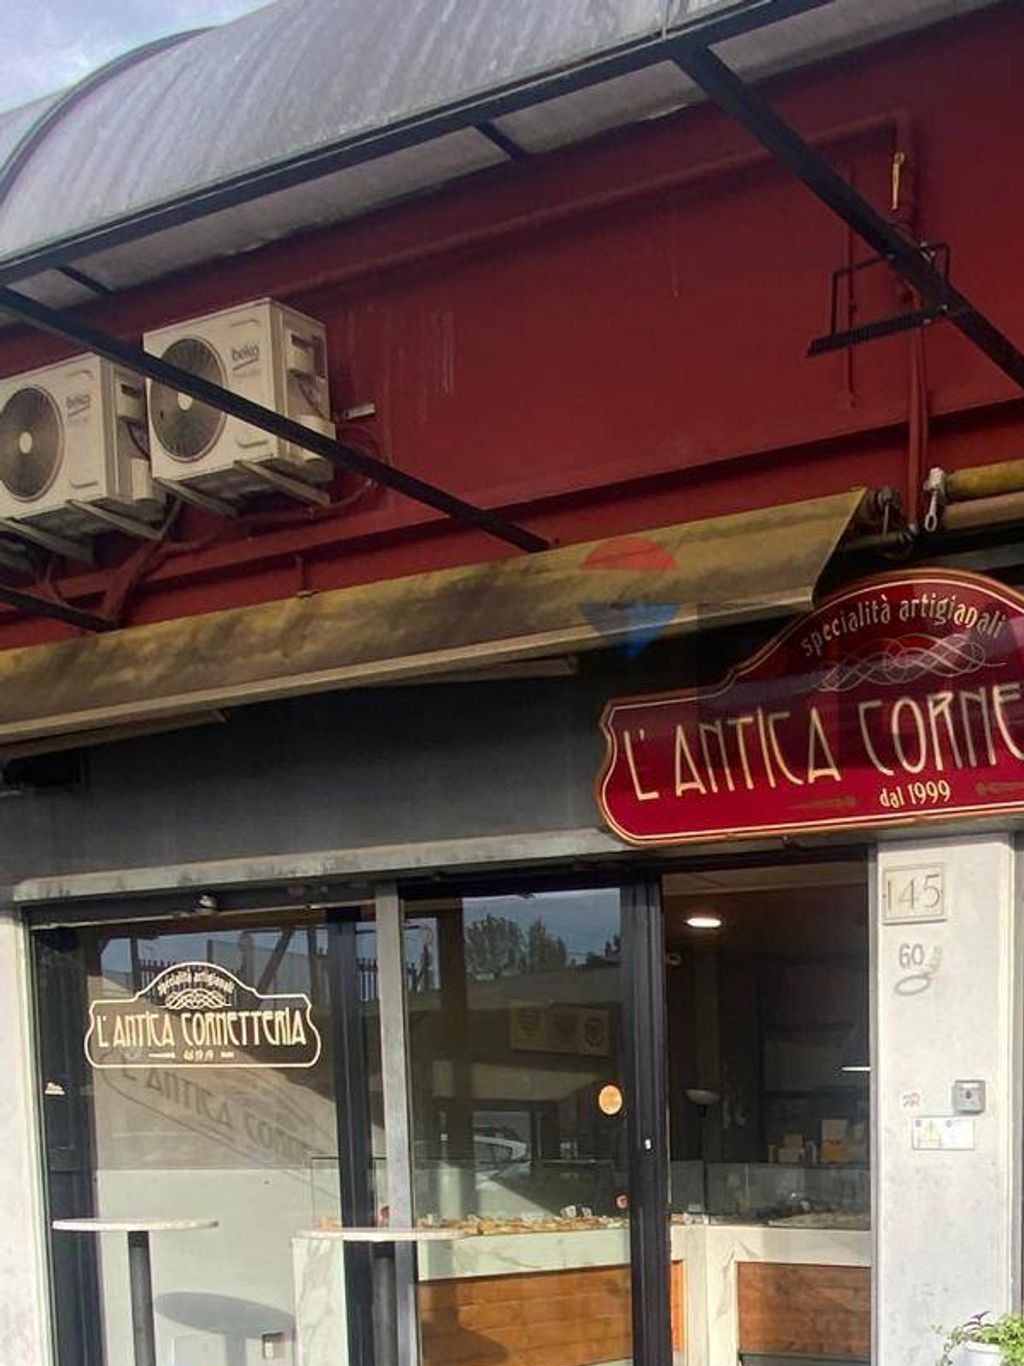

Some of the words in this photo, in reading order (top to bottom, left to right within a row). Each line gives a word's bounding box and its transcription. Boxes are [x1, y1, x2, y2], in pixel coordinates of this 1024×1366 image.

[801, 594, 891, 658] specialità
[879, 785, 905, 809] dal
[907, 779, 951, 805] 1999
[886, 873, 941, 911] 145
[898, 942, 925, 970] 60
[180, 1007, 308, 1047] CORNETTERIA
